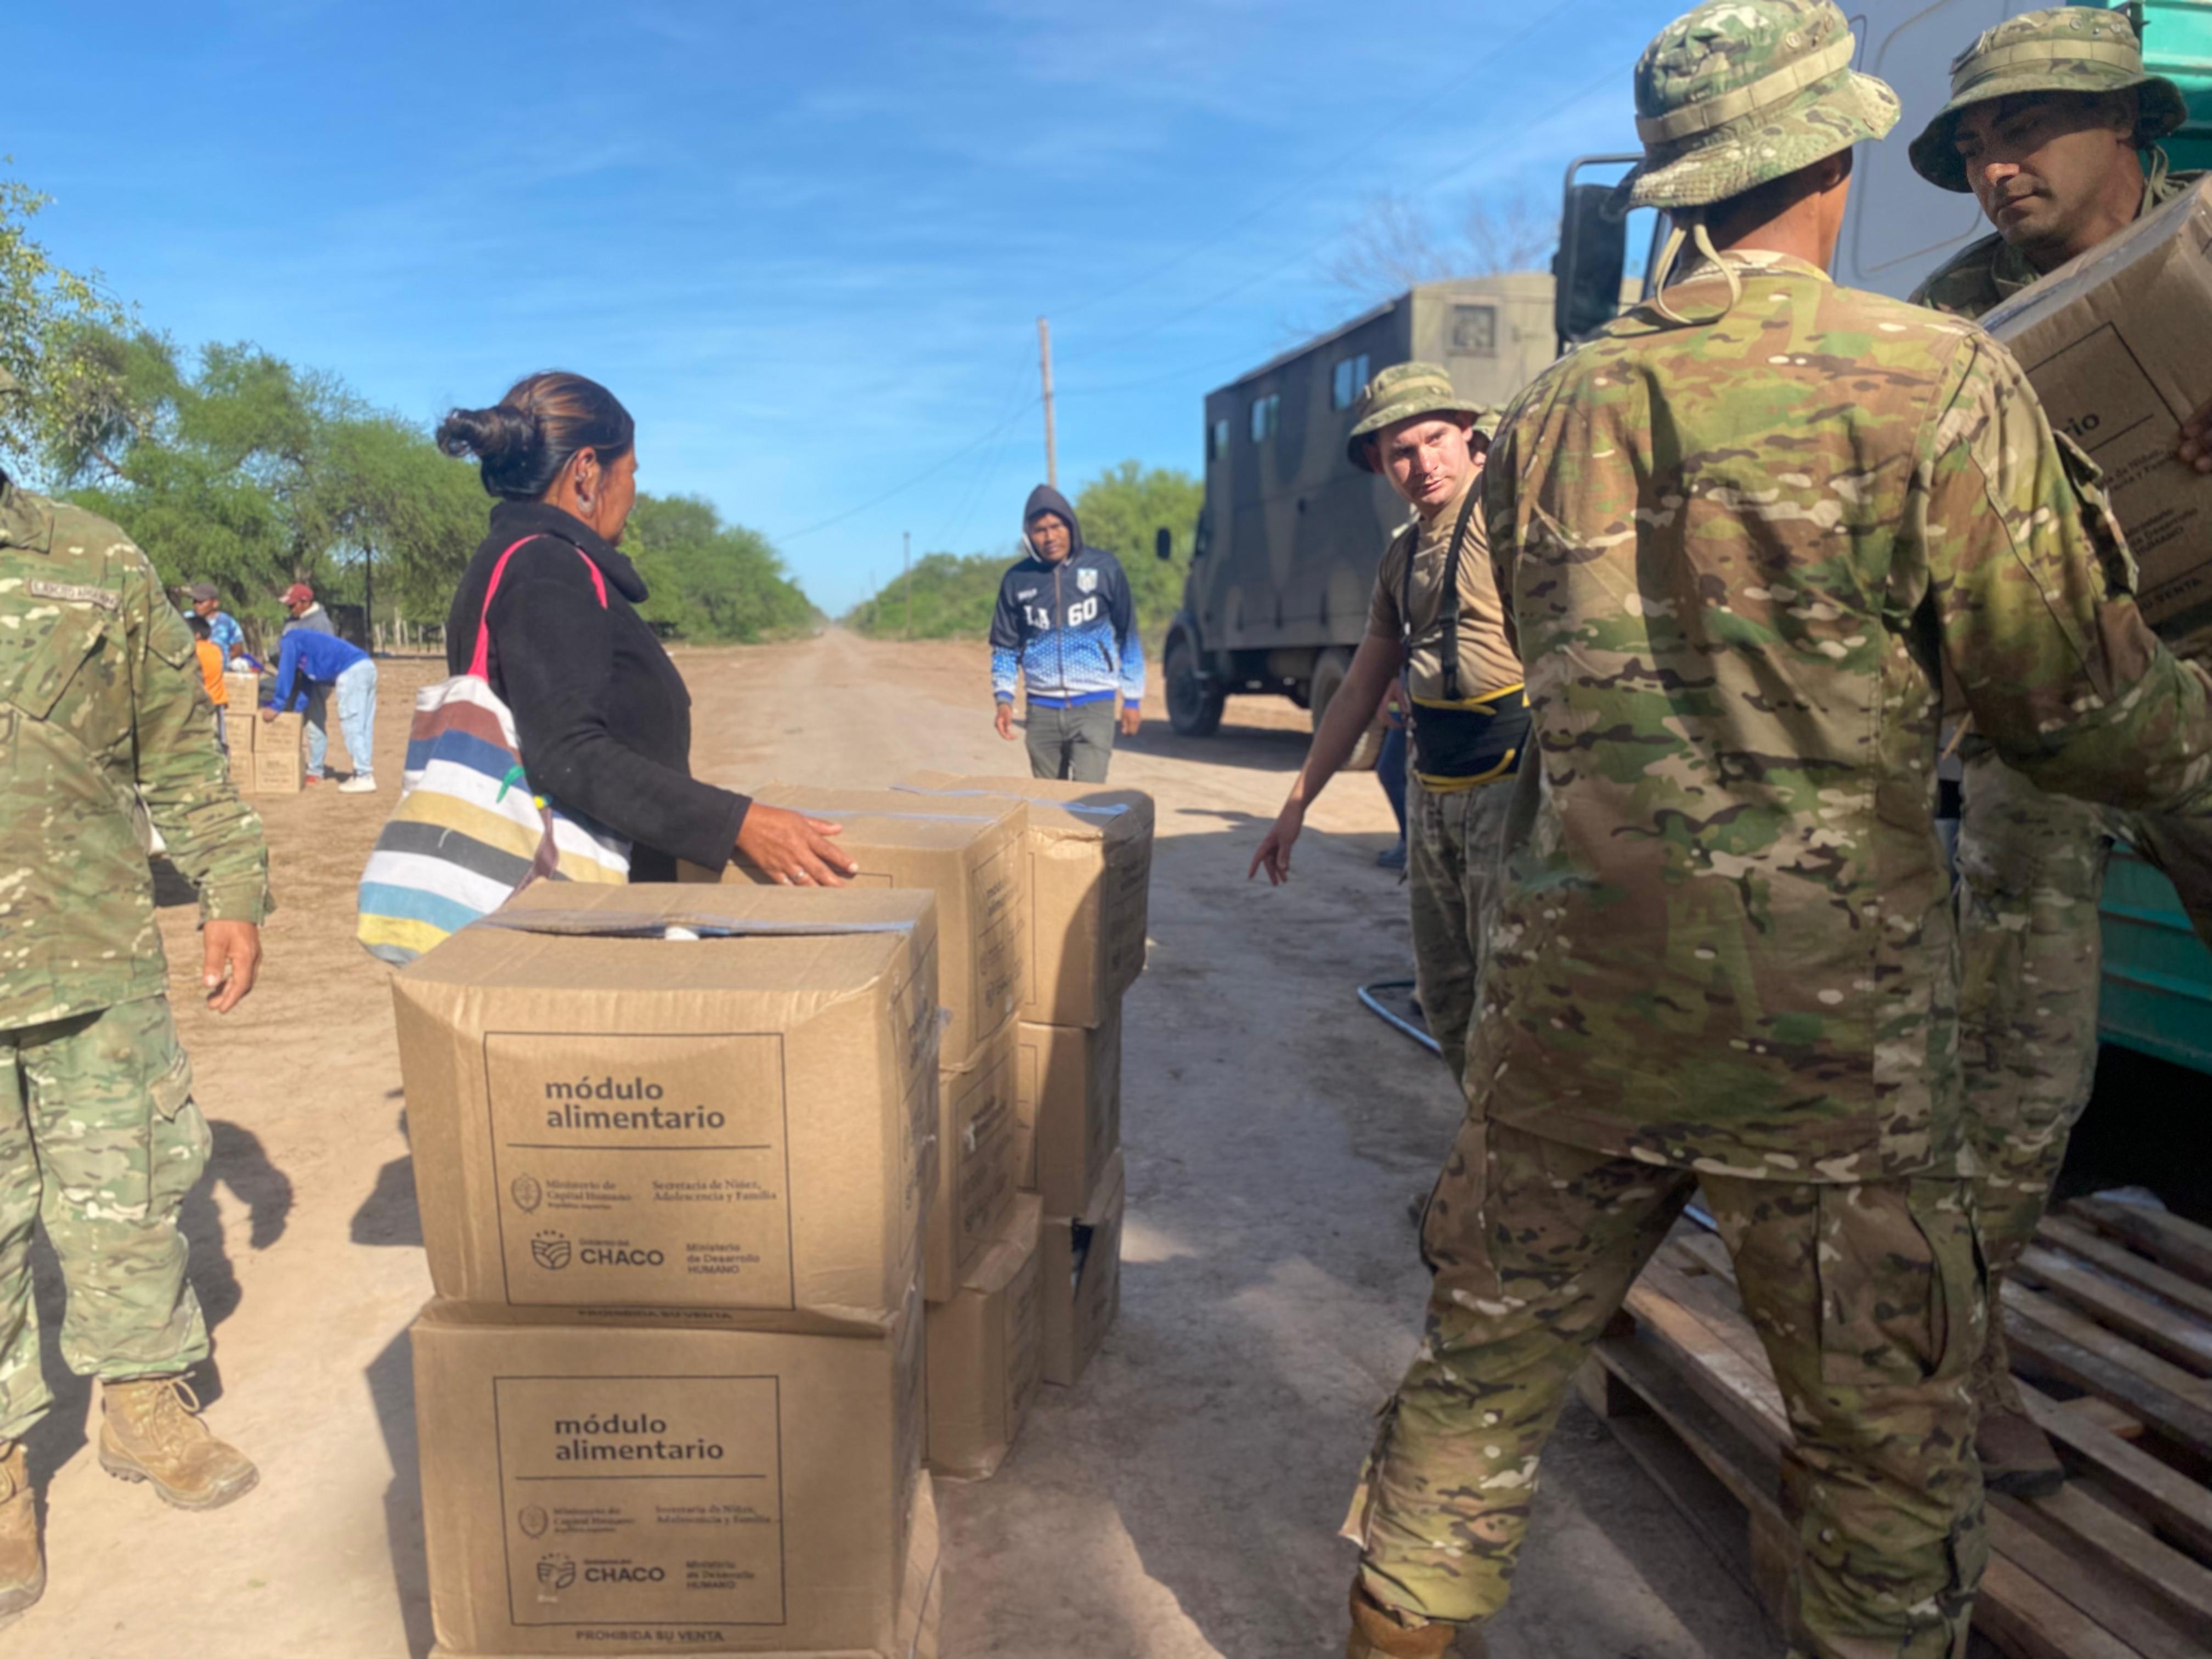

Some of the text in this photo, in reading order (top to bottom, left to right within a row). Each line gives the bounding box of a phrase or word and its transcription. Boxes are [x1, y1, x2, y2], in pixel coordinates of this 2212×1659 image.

[1068, 597, 1097, 627] 60
[545, 1076, 664, 1100] módulo
[546, 1104, 725, 1129] alimentario
[580, 1248, 664, 1266] CHACO
[688, 1265, 740, 1274] HUMANO
[555, 1414, 667, 1435] módulo
[556, 1438, 724, 1461] alimentario
[585, 1567, 665, 1582] CHACO
[576, 1630, 724, 1641] PROHIBIDA SU VENTA
